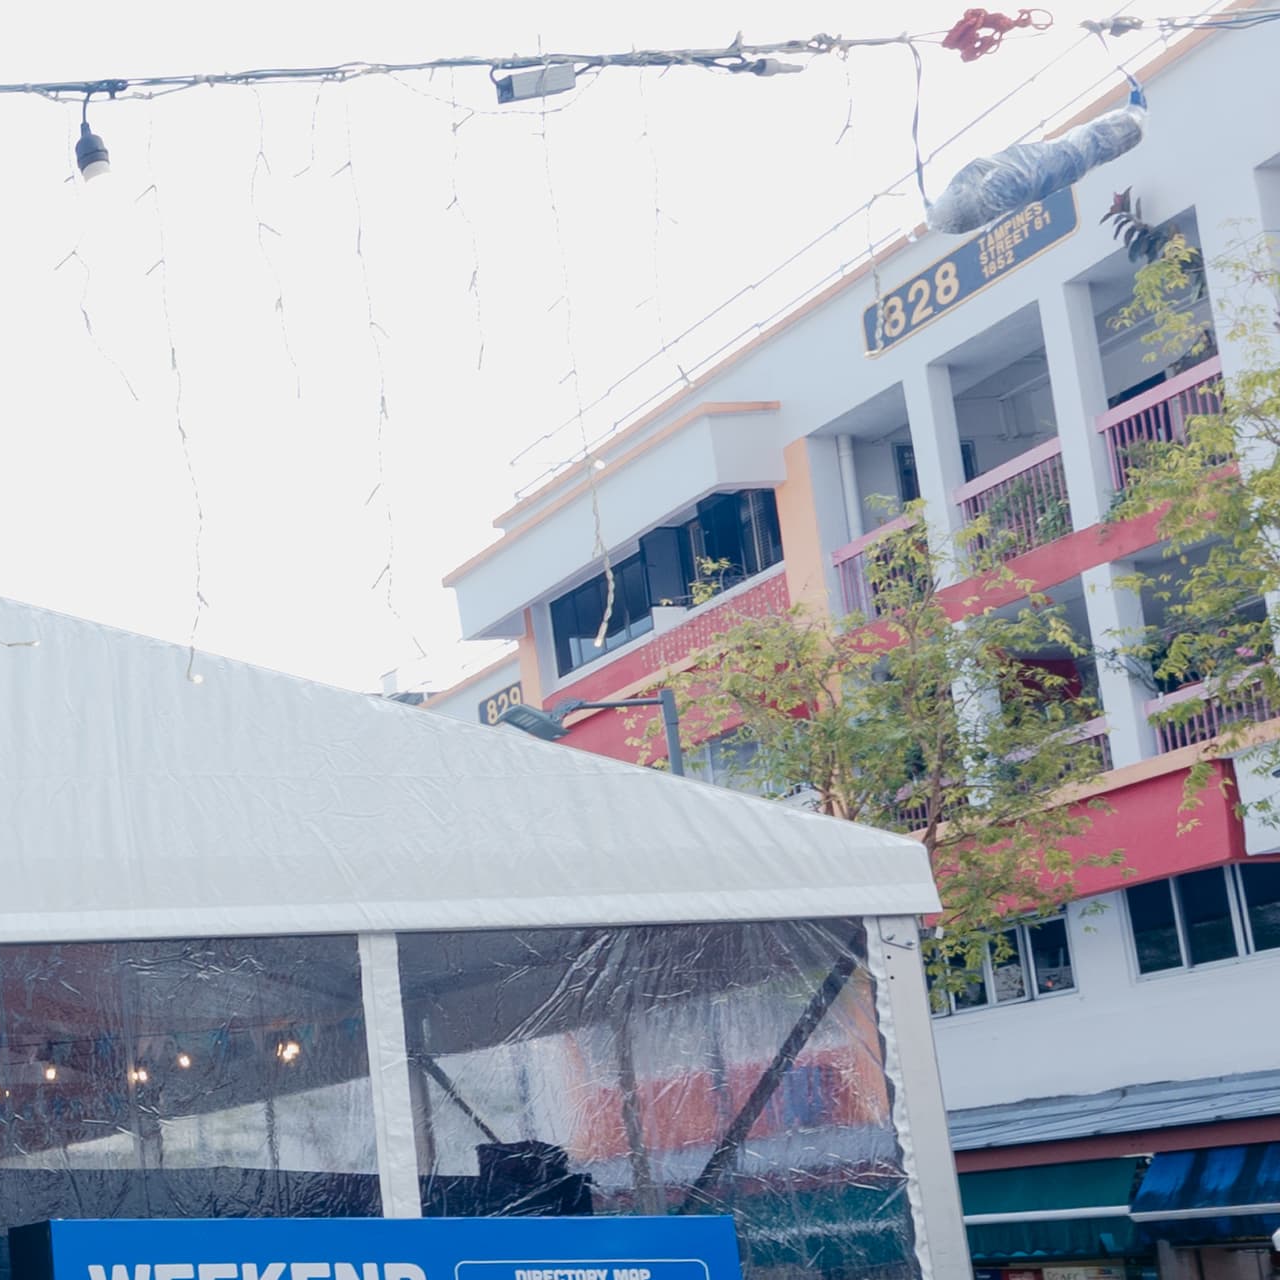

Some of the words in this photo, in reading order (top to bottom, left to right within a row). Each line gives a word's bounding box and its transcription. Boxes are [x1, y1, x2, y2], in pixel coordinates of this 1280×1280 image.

[977, 201, 1043, 249] TAMPINES
[978, 227, 1030, 265] STREET
[883, 261, 960, 338] 828
